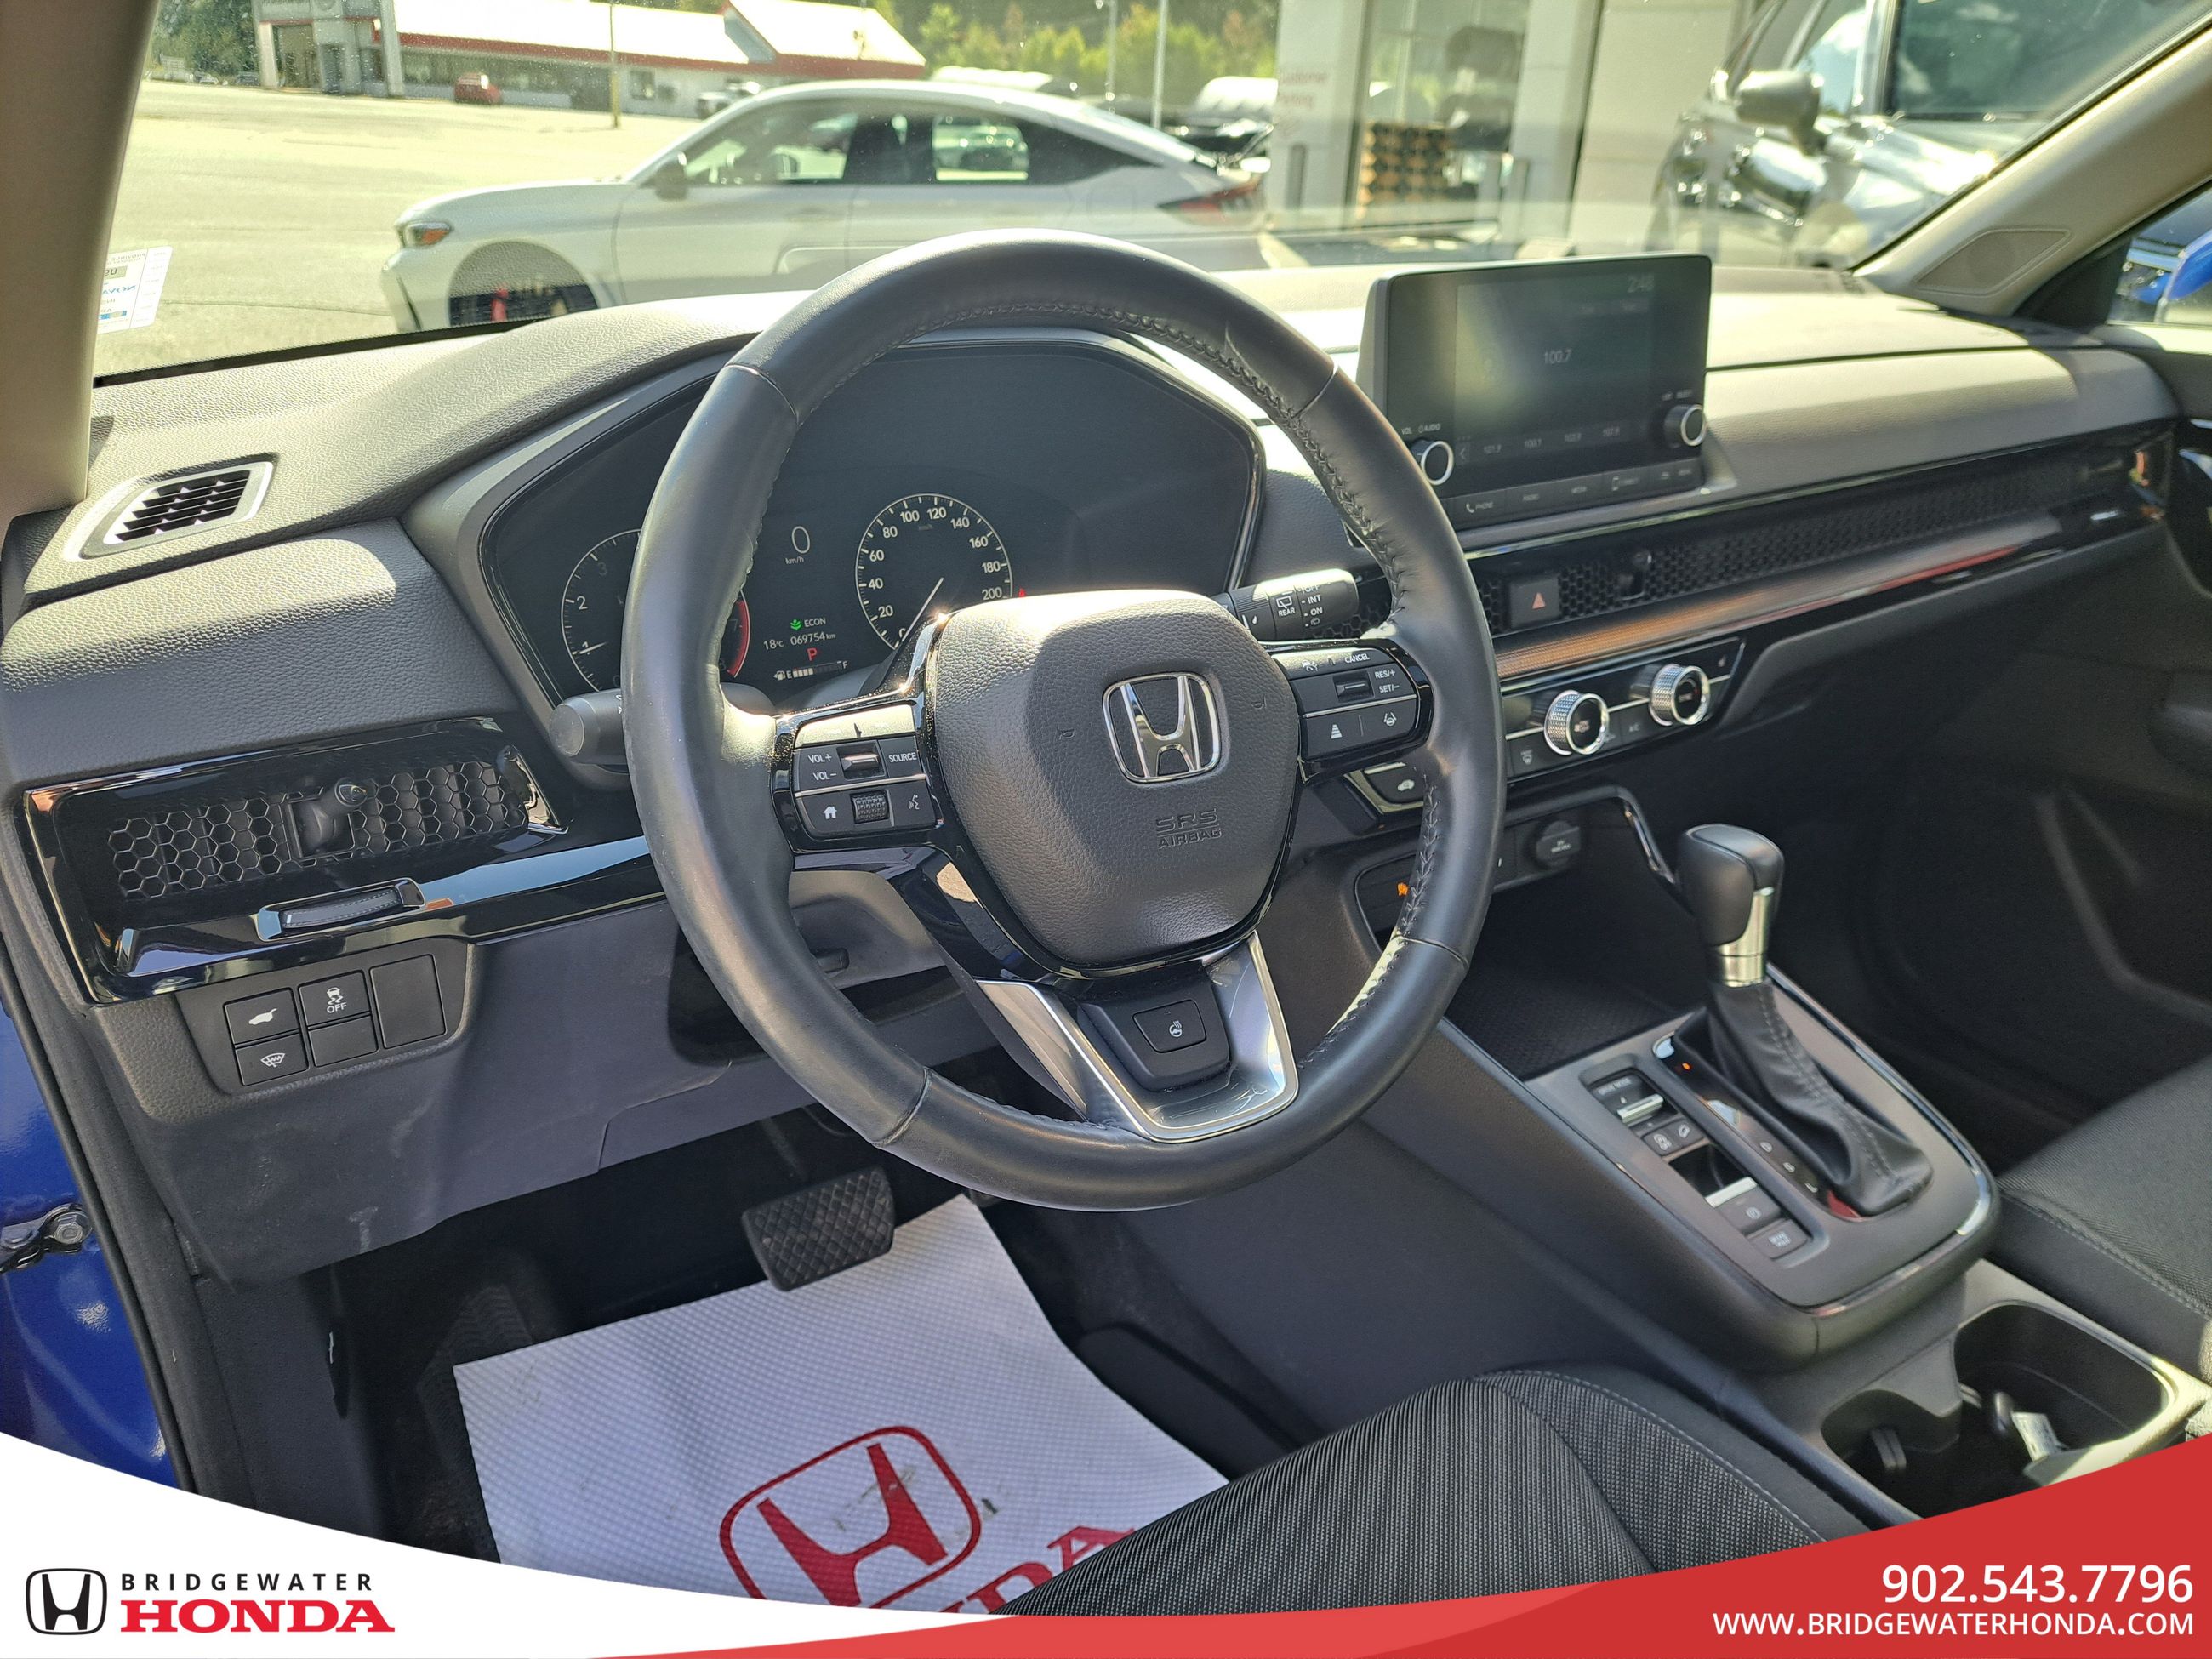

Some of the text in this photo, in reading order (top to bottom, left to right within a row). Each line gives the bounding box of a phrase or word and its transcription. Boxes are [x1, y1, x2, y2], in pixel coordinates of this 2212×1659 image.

[1543, 350, 1572, 364] 100.7
[900, 510, 920, 523] 100
[927, 507, 947, 520] 120
[950, 516, 970, 529] 140
[882, 526, 898, 539] 80
[969, 536, 989, 549] 160
[785, 556, 804, 565] km/h
[869, 550, 885, 562] 60
[982, 561, 1001, 573] 180
[868, 578, 883, 590] 40
[982, 587, 1002, 600] 200
[1307, 595, 1321, 604] INT
[577, 596, 588, 610] 2
[878, 605, 894, 618] 20
[1278, 607, 1296, 617] REAR
[1310, 607, 1323, 616] ON
[804, 618, 826, 628] ECON
[807, 647, 818, 661] P
[1344, 653, 1370, 664] CANCEL
[889, 752, 917, 762] SOURCE
[1156, 809, 1218, 832] SRS
[1158, 827, 1222, 849] AIRBAG
[327, 1001, 347, 1014] OFF
